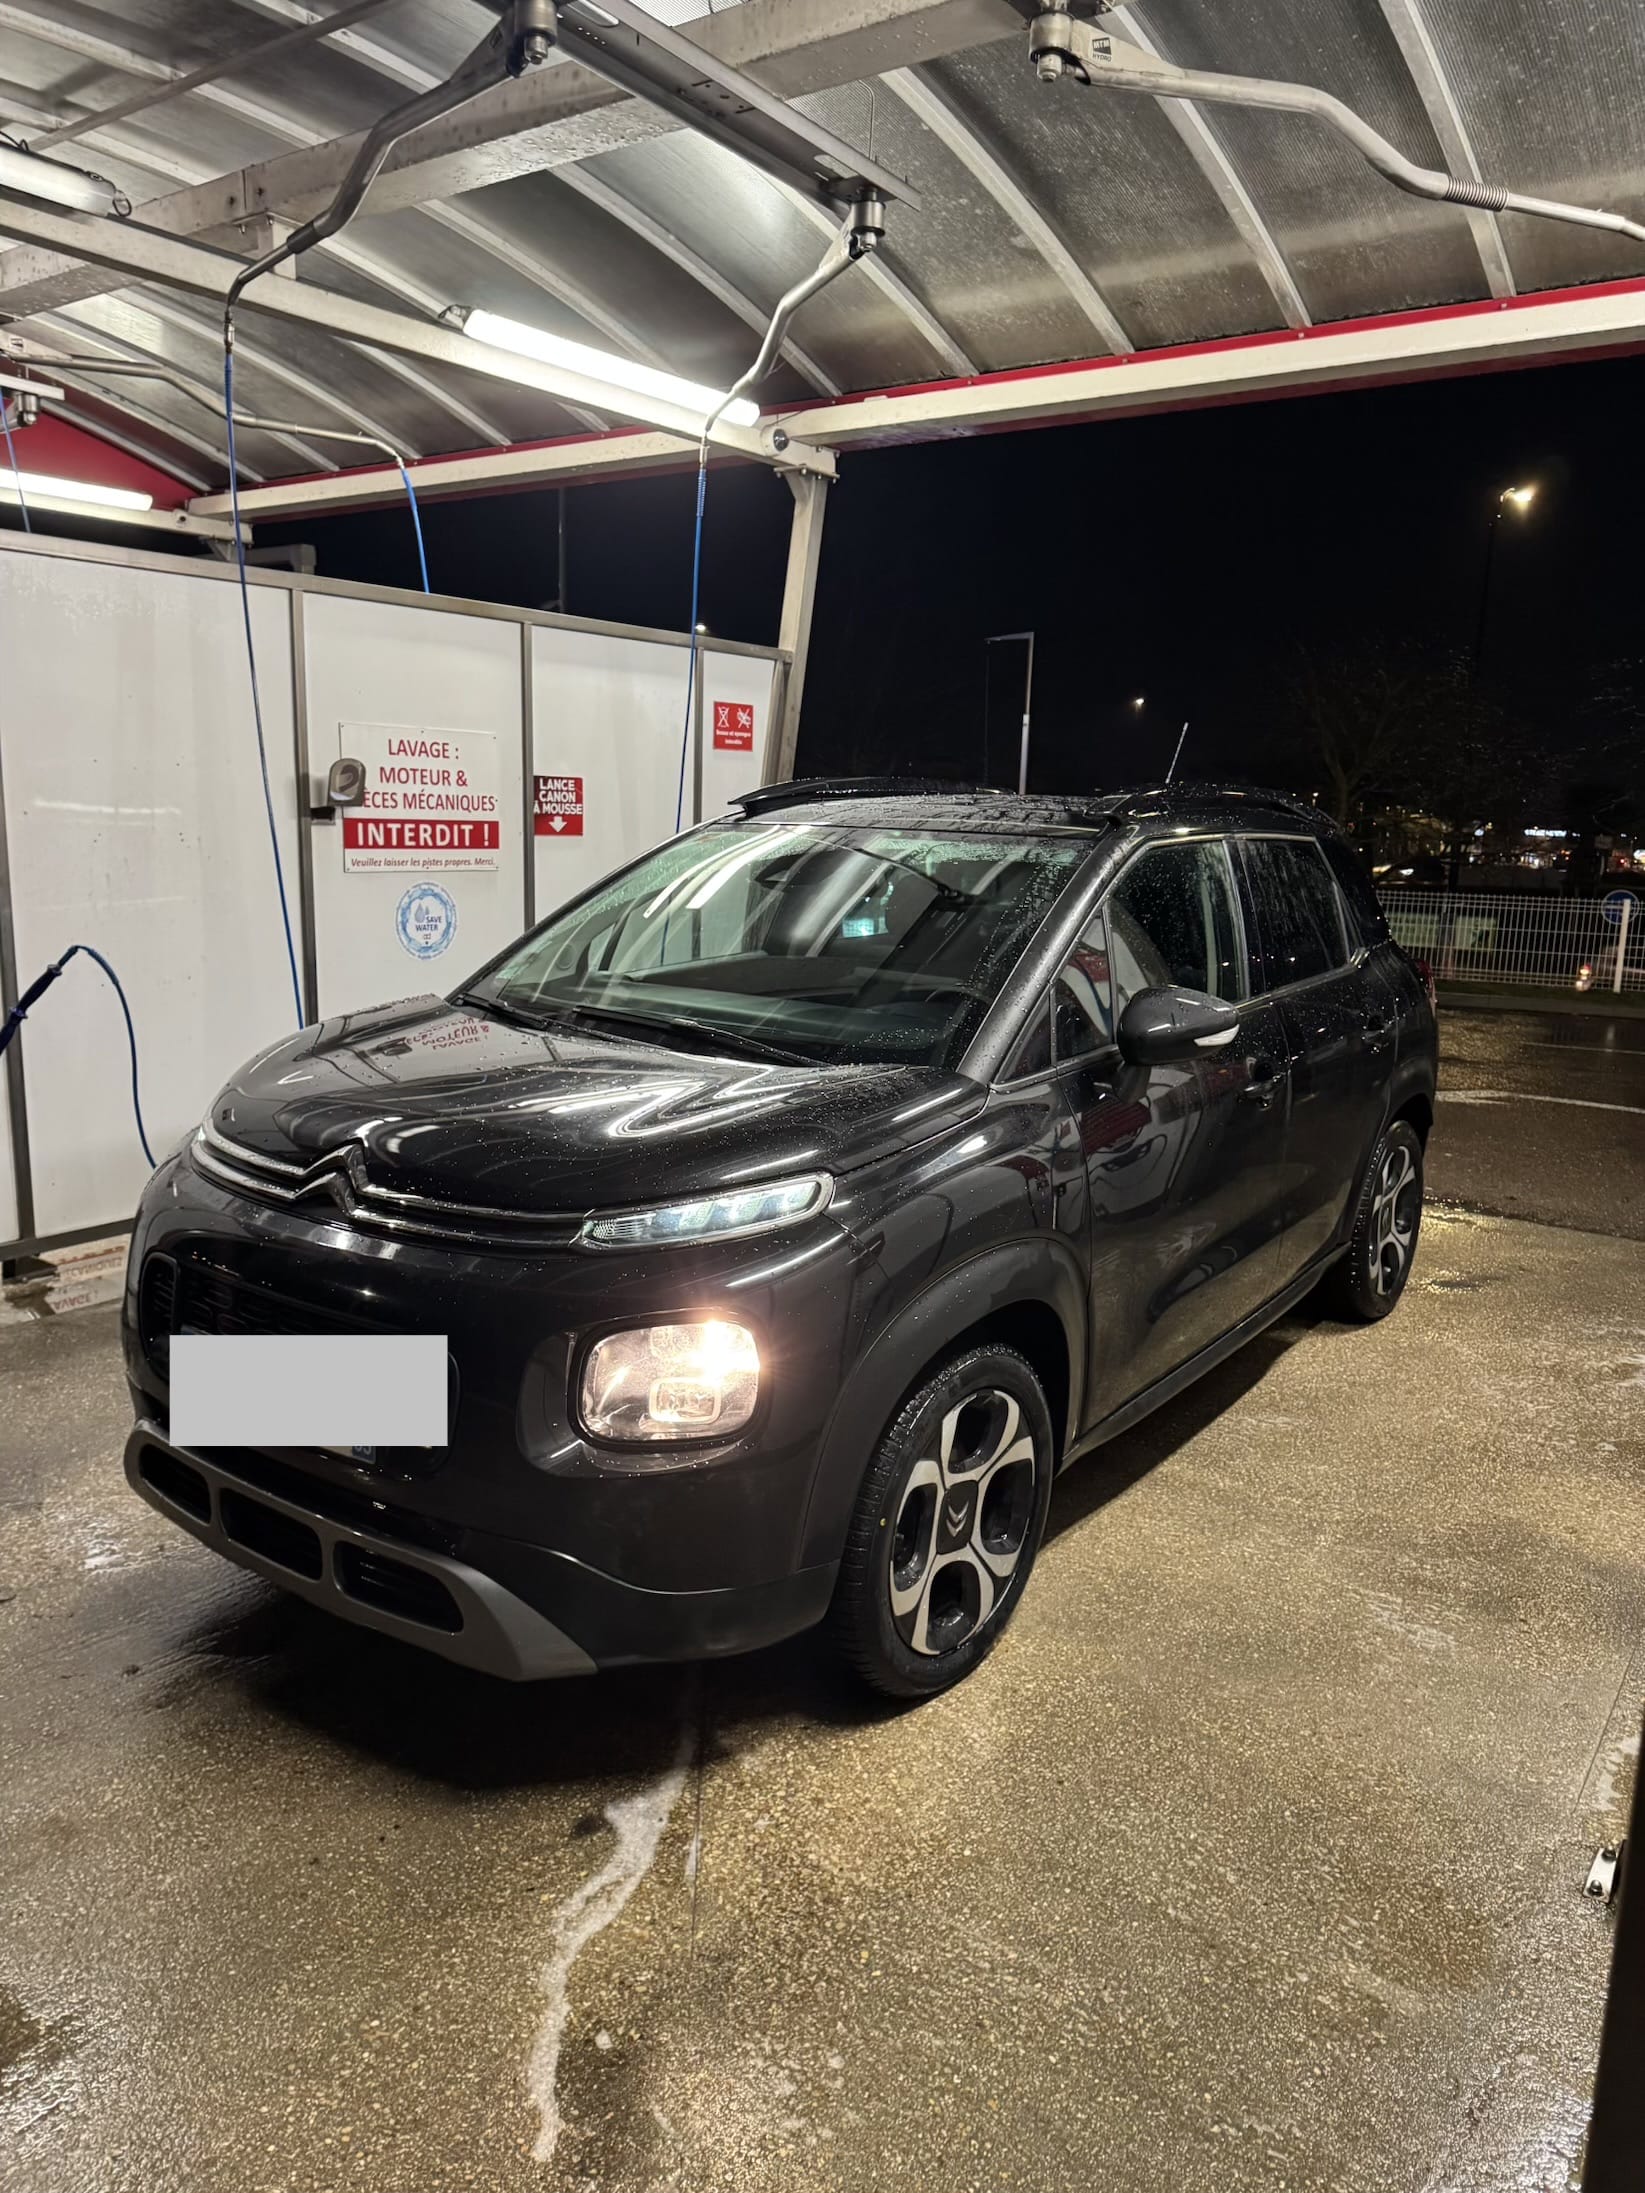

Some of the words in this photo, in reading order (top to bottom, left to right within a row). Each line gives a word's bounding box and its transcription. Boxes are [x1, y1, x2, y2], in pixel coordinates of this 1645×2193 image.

[388, 738, 450, 759] LAVAGE
[379, 766, 451, 787] MOTEUR
[456, 770, 468, 787] &
[540, 778, 576, 791] LANCE
[403, 789, 495, 813] MÉCANIQUES
[539, 790, 576, 803] CANON
[542, 802, 583, 815] MOUSSE
[357, 822, 474, 847] INTERDIT
[483, 823, 489, 847] !
[351, 858, 382, 867] Veuillez
[383, 858, 408, 867] laisser
[410, 858, 420, 866] les
[422, 858, 443, 868] pistes
[415, 924, 438, 932] WATER
